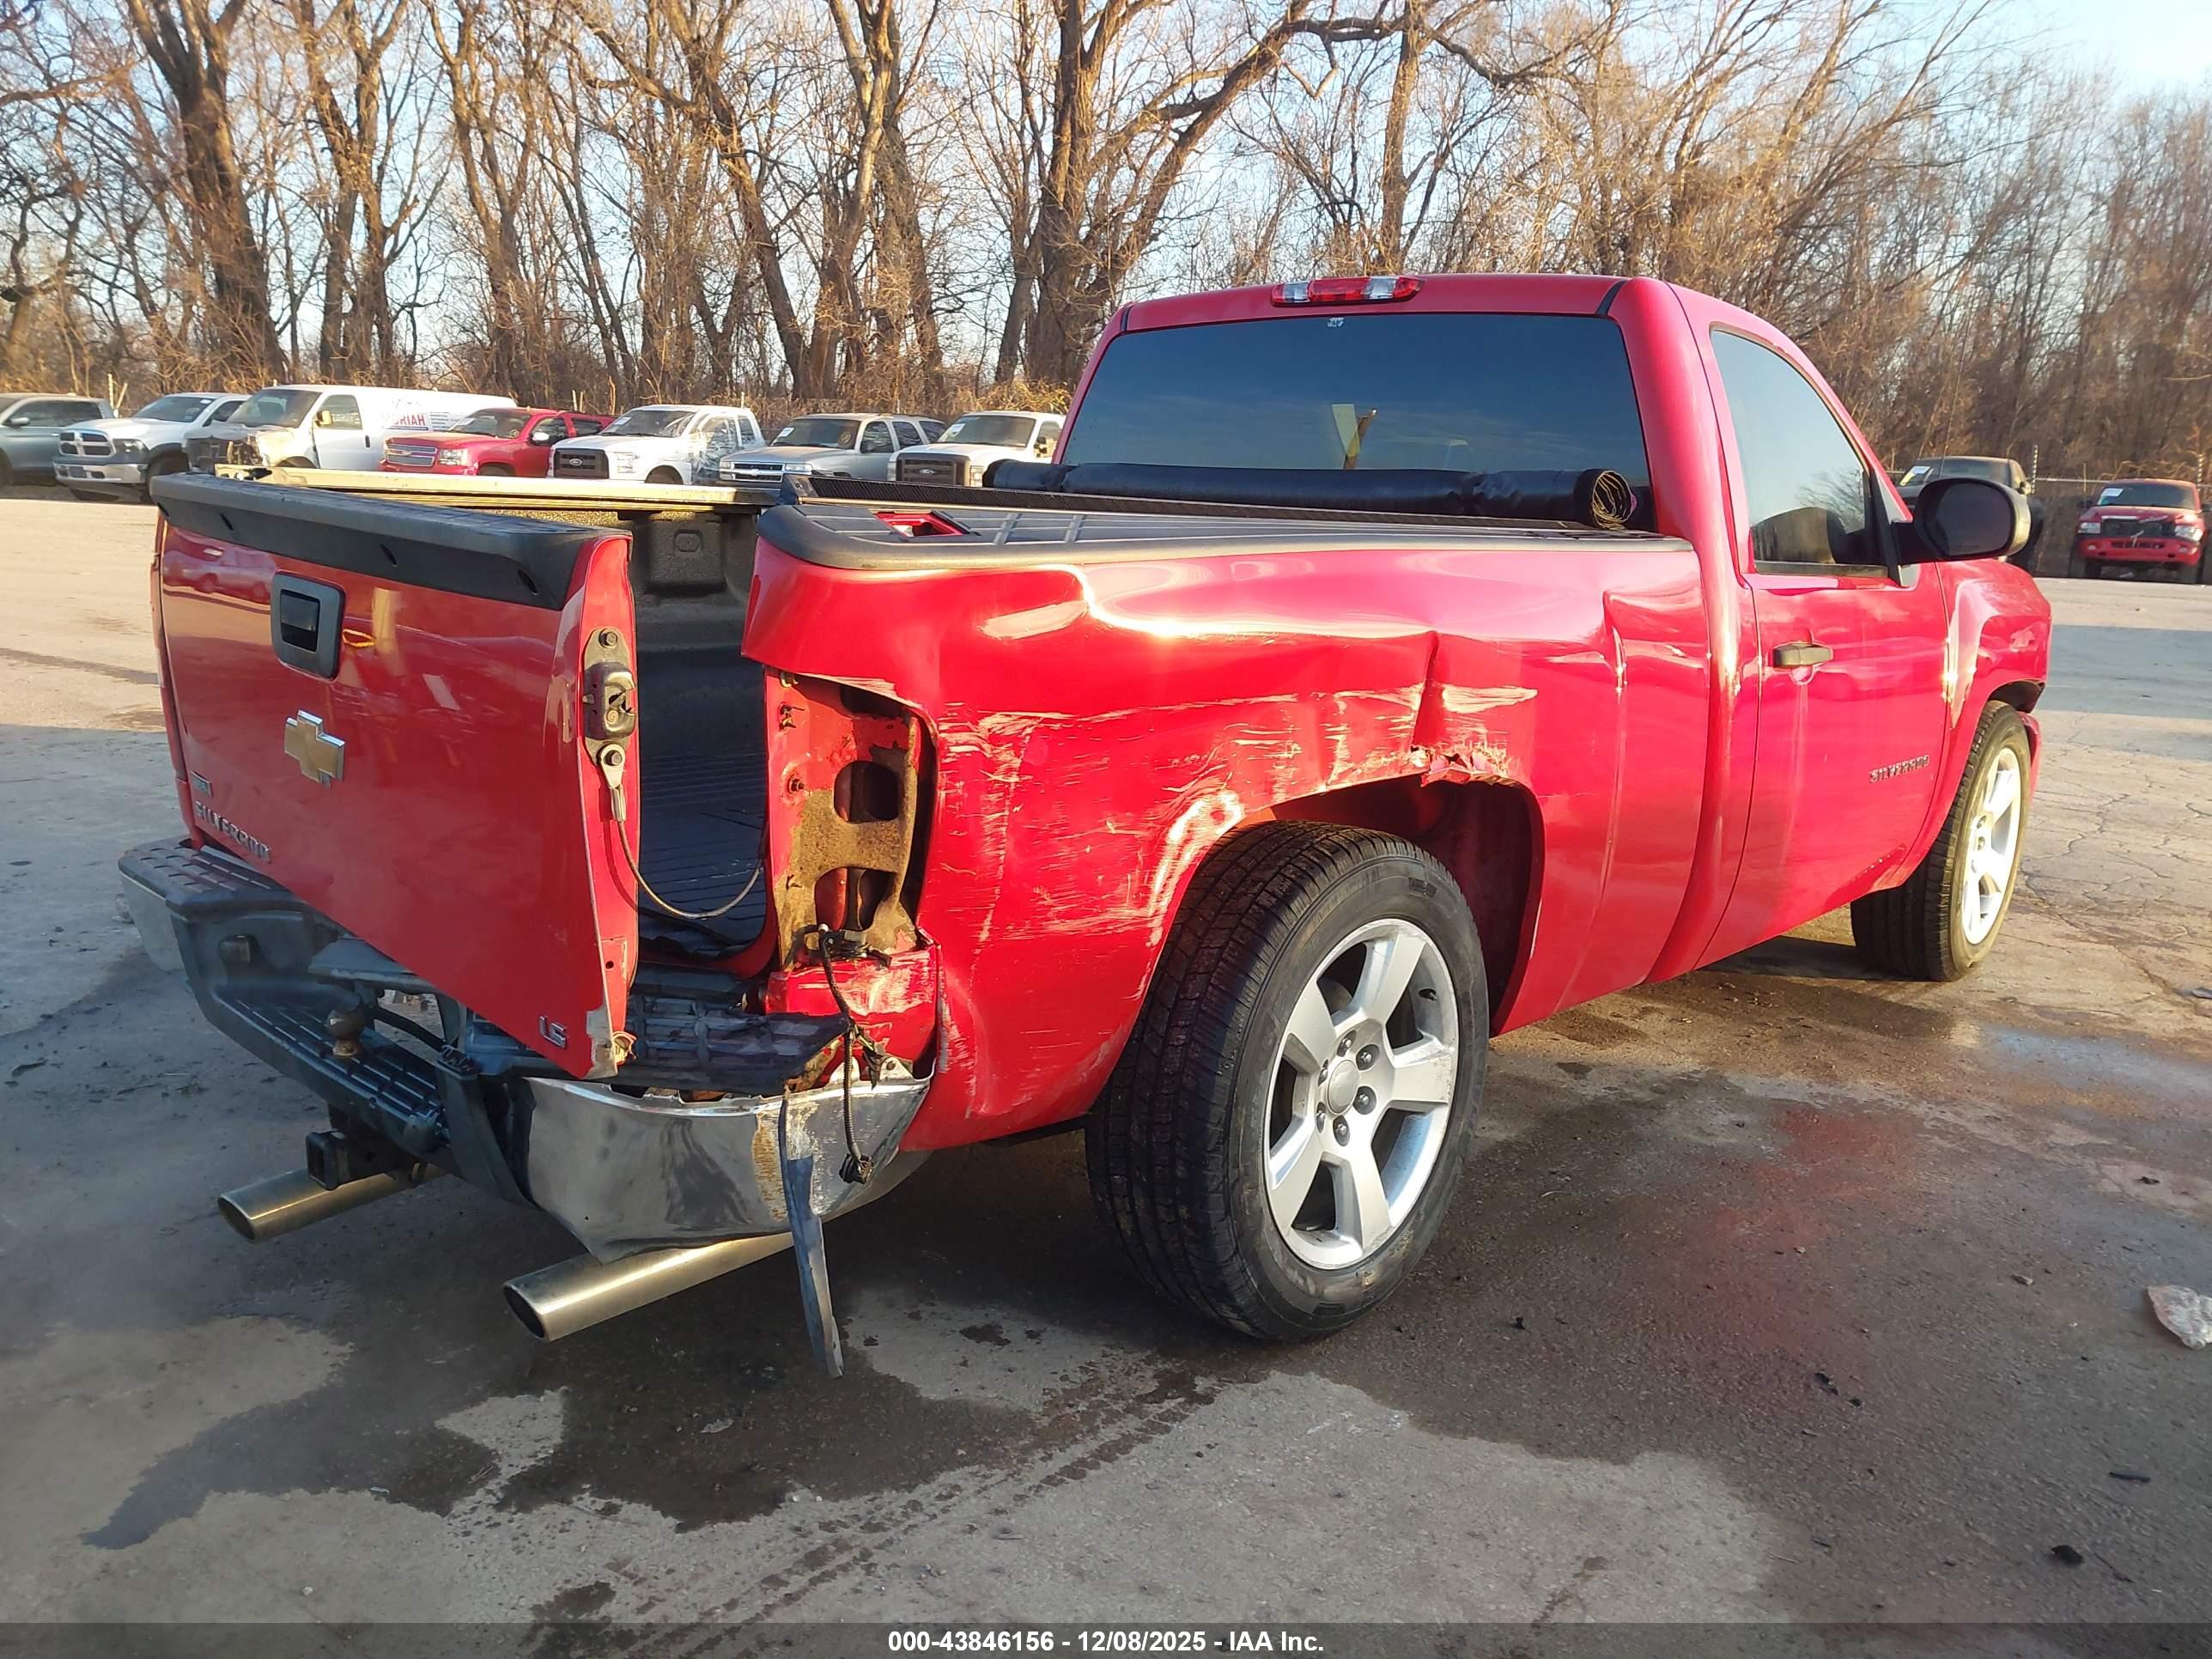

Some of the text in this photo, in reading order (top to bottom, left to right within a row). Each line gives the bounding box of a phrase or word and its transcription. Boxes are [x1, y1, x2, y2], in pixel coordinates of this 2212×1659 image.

[1869, 755, 1930, 783] SILVERADO
[194, 800, 271, 864] SILVERADO
[538, 1016, 568, 1049] LS
